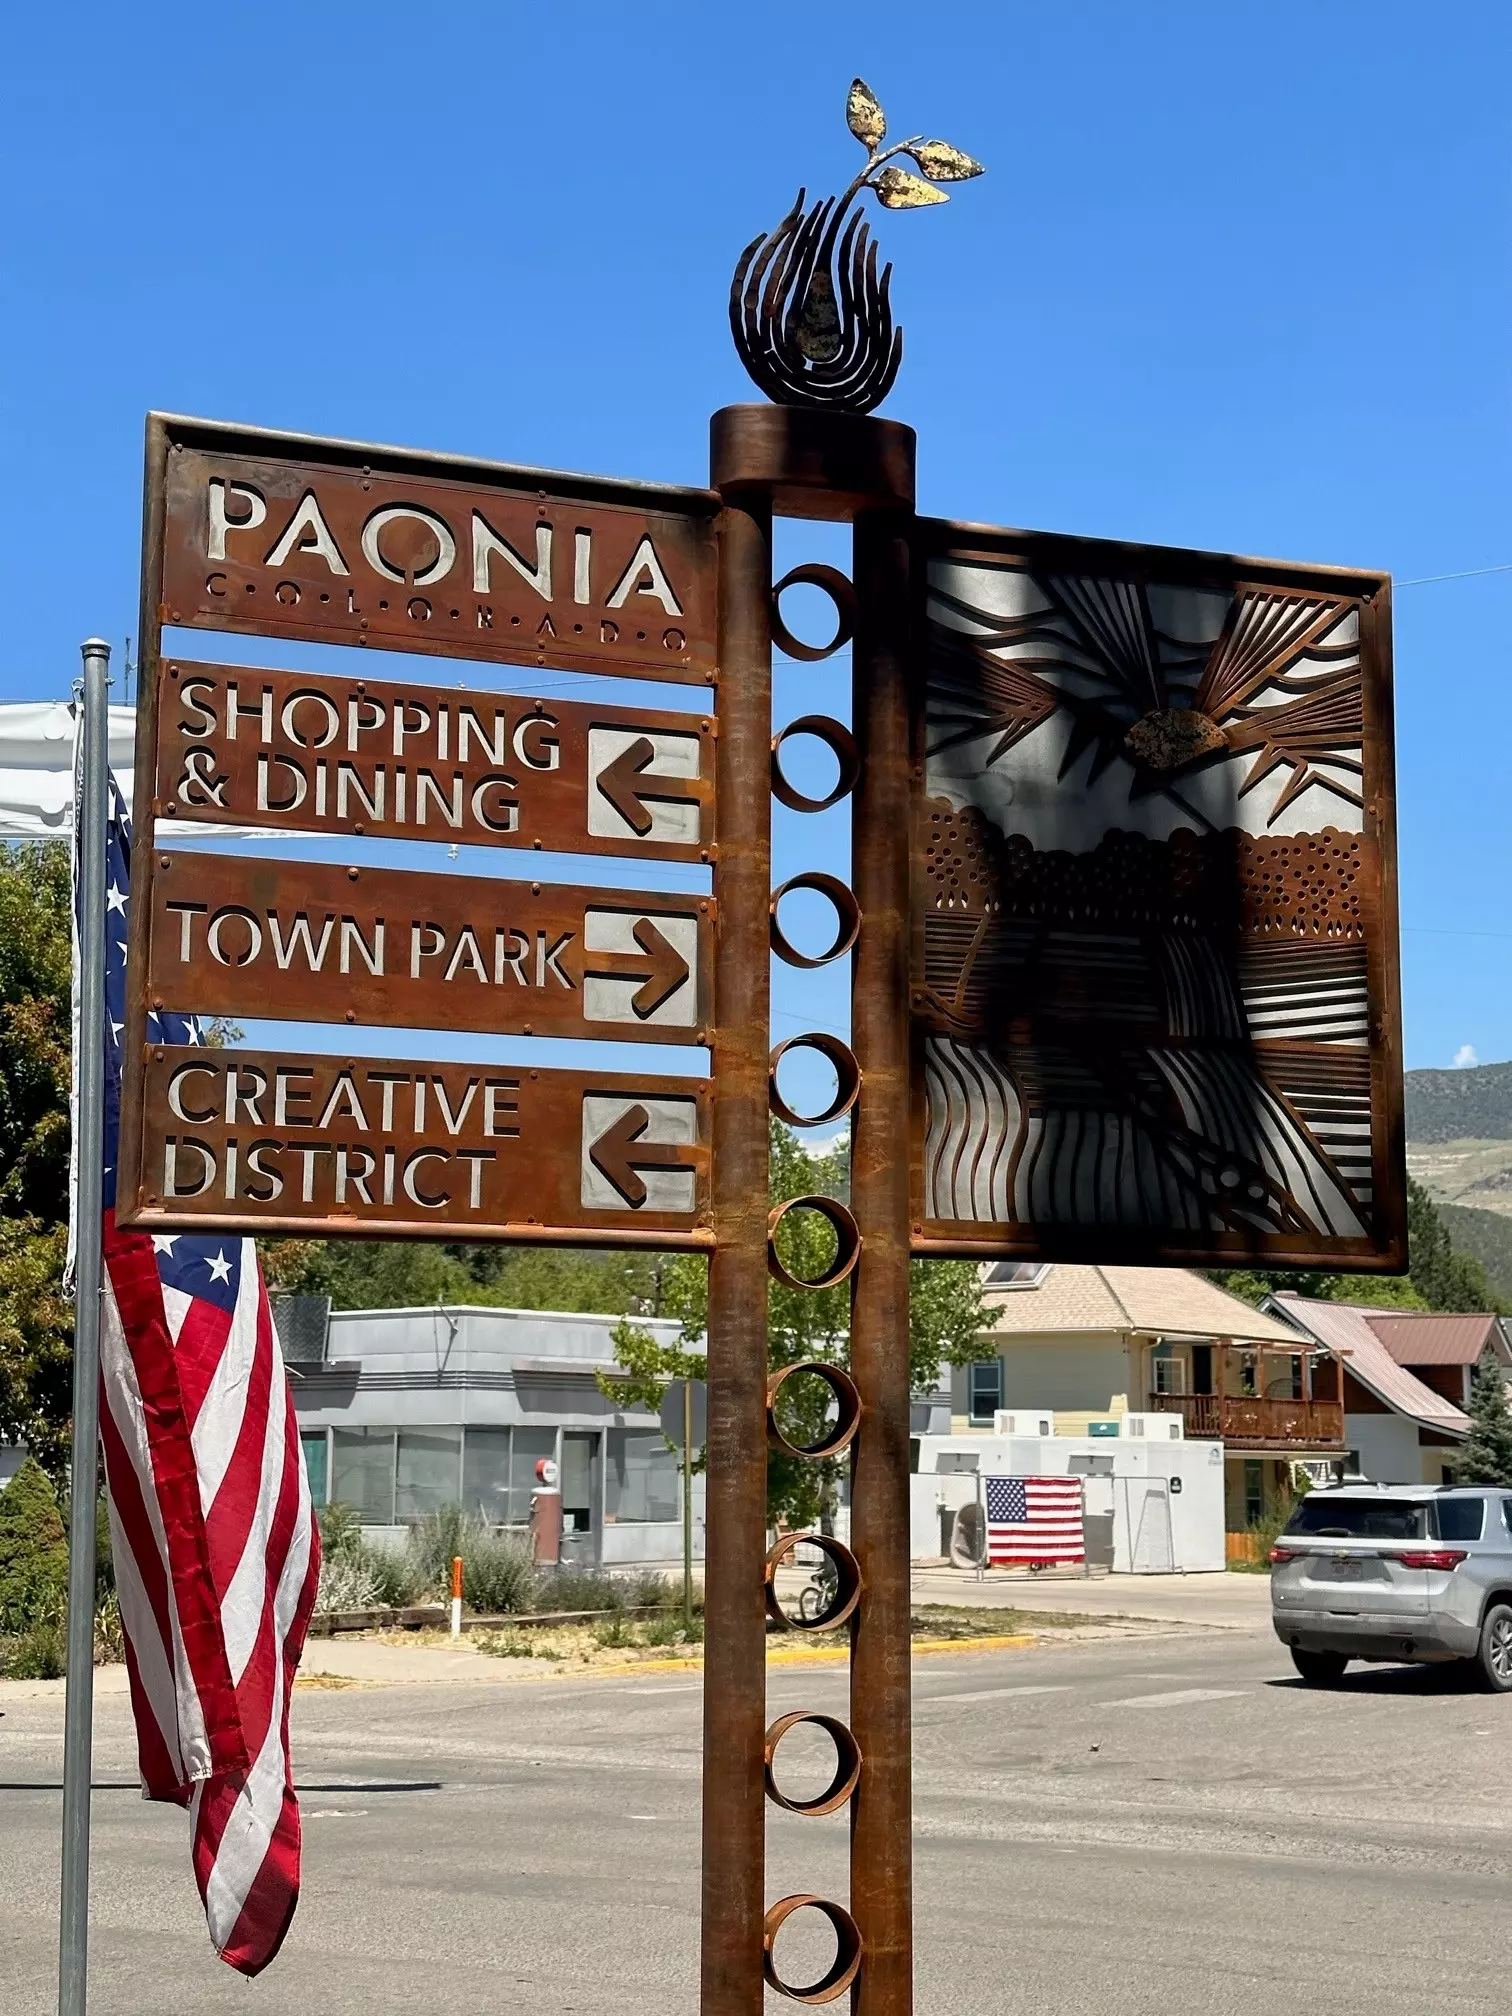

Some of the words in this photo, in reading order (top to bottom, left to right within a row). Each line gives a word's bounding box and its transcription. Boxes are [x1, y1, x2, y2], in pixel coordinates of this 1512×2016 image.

[207, 476, 685, 617] PAONIA
[177, 677, 562, 772] SHOPPING
[177, 745, 231, 808] &
[256, 752, 520, 833] DINING
[166, 901, 385, 977] TOWN
[410, 920, 578, 990] PARK
[167, 1060, 521, 1139] CREATIVE
[163, 1135, 498, 1210] DISTRICT
